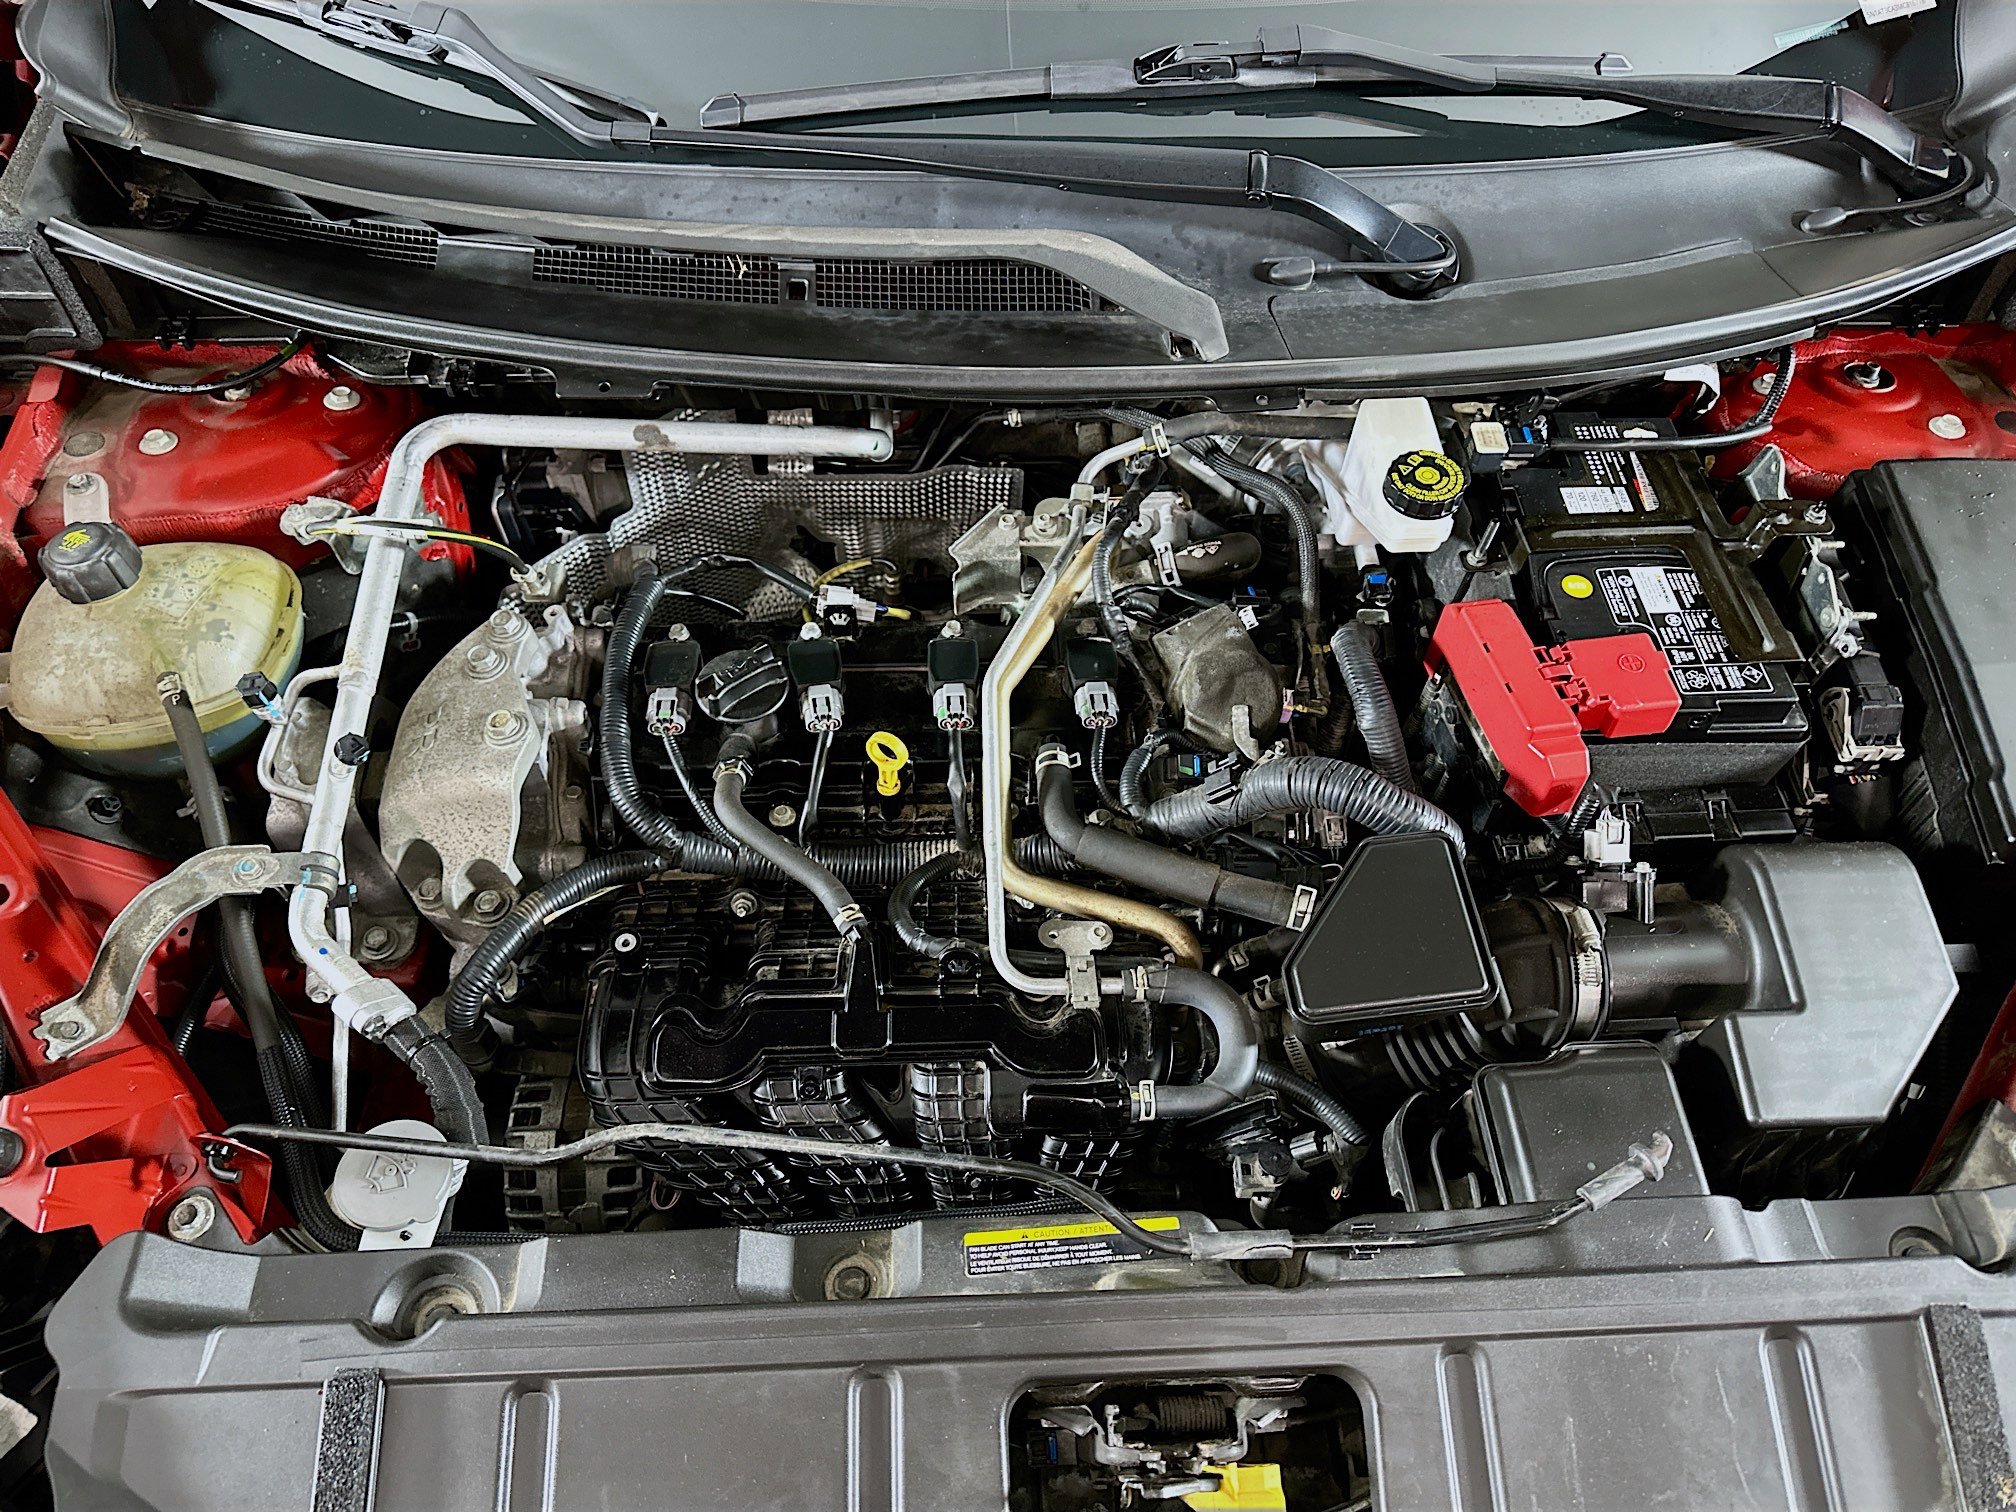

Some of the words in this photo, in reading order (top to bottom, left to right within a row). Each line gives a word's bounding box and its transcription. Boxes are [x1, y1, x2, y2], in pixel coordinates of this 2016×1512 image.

[1033, 1228, 1070, 1239] CAUTION
[980, 1244, 997, 1252] BLADE
[1008, 1248, 1036, 1256] PERSONAL
[1080, 1255, 1113, 1264] APPROCHER
